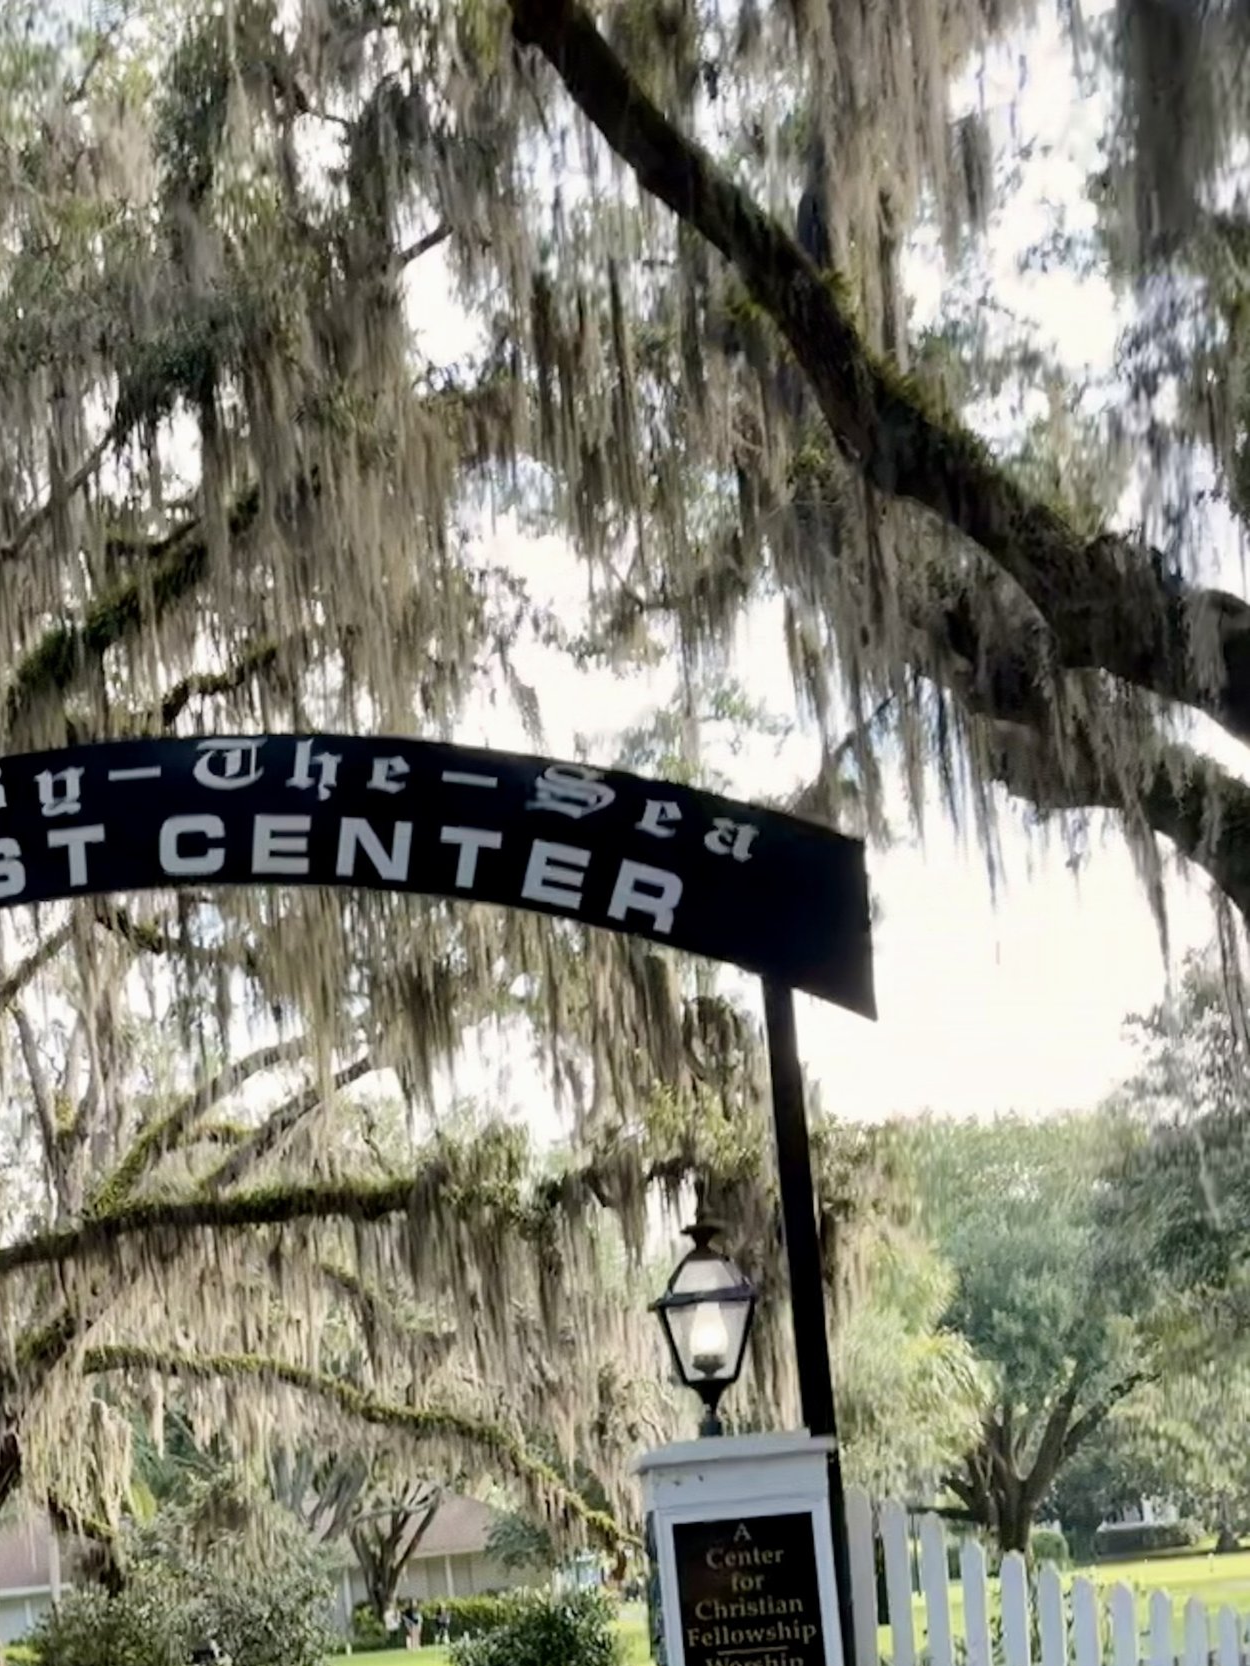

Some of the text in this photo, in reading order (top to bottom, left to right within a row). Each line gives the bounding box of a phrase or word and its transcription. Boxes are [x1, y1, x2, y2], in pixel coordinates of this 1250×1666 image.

[159, 813, 684, 934] CENTER
[733, 1522, 751, 1542] A
[706, 1548, 785, 1570] Center
[730, 1572, 765, 1592] for
[695, 1598, 804, 1622] Christian
[687, 1619, 817, 1648] Fellowship
